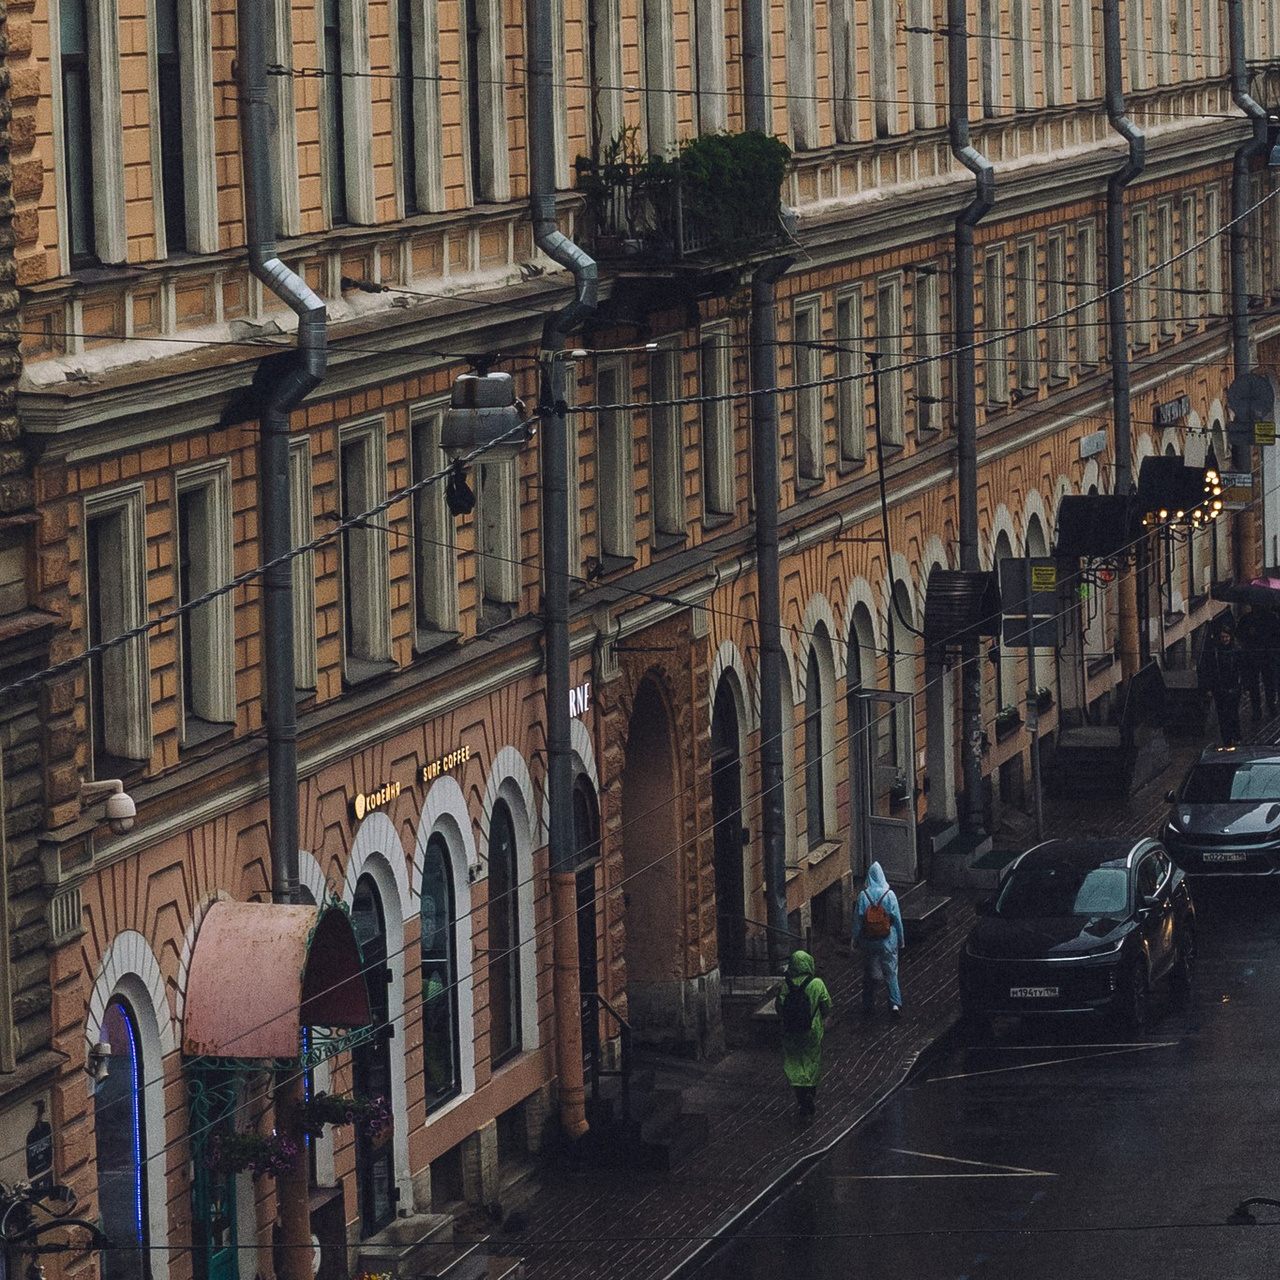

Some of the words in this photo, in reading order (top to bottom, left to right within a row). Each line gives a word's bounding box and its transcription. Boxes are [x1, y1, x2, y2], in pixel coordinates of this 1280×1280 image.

[569, 683, 590, 718] RNE
[423, 761, 441, 782] SURF
[443, 745, 470, 772] COFFEE
[366, 781, 400, 812] КОФЕЙНЯ
